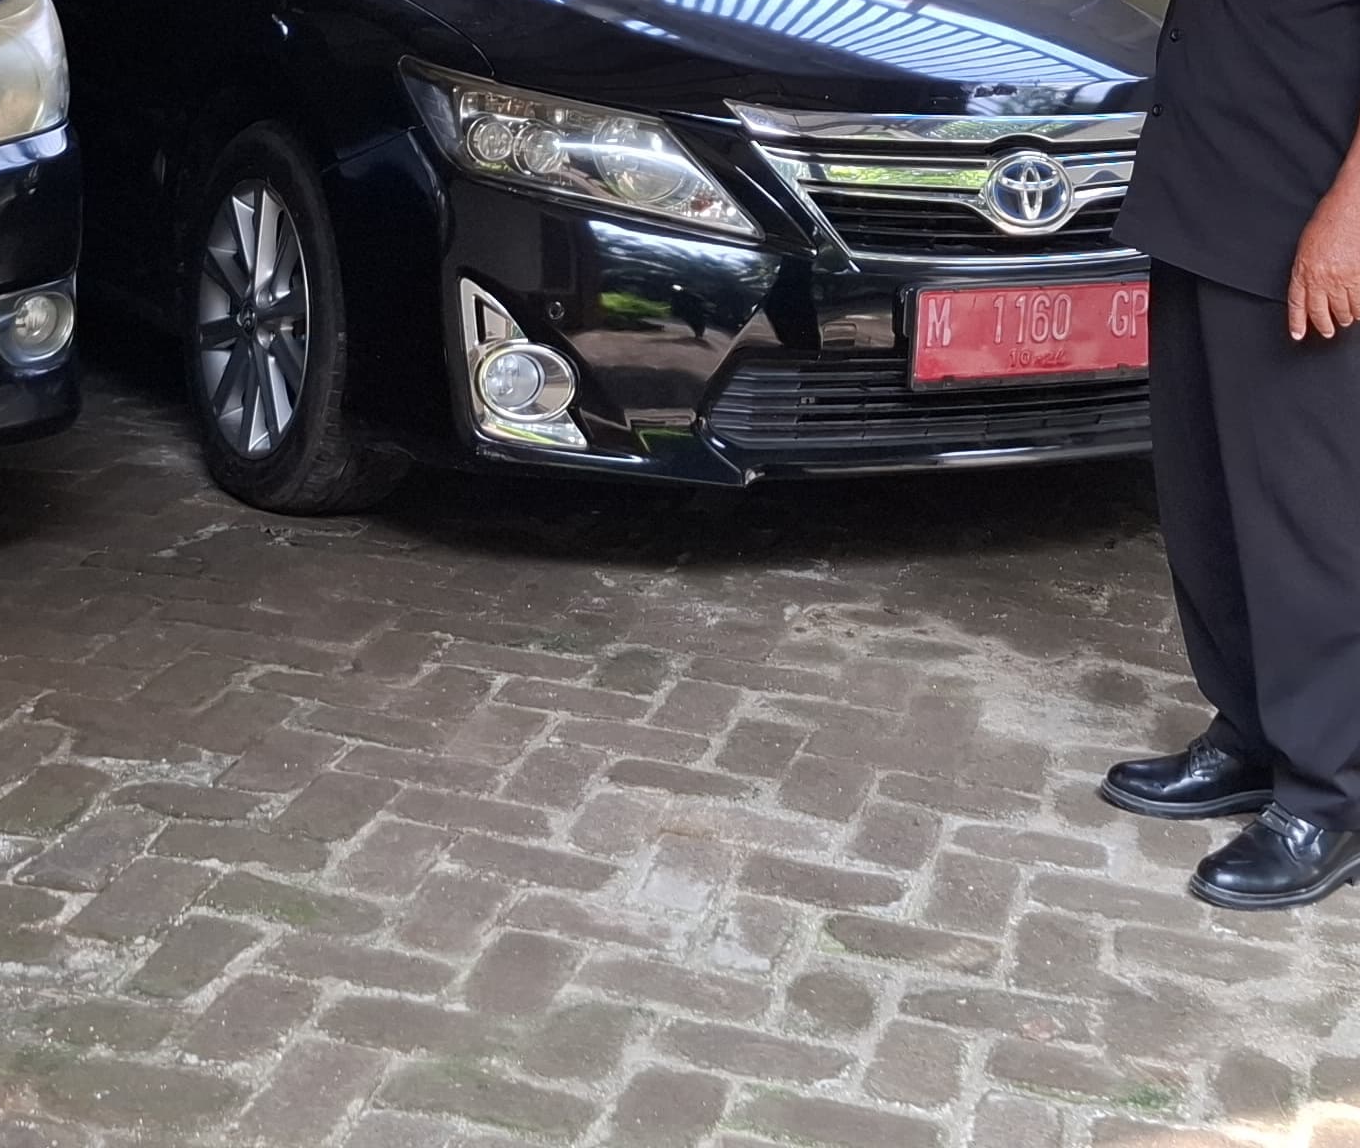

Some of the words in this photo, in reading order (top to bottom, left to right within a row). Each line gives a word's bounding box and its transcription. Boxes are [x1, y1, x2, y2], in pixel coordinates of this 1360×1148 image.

[926, 298, 952, 348] M
[993, 293, 1072, 344] 1160
[1108, 288, 1149, 338] GP
